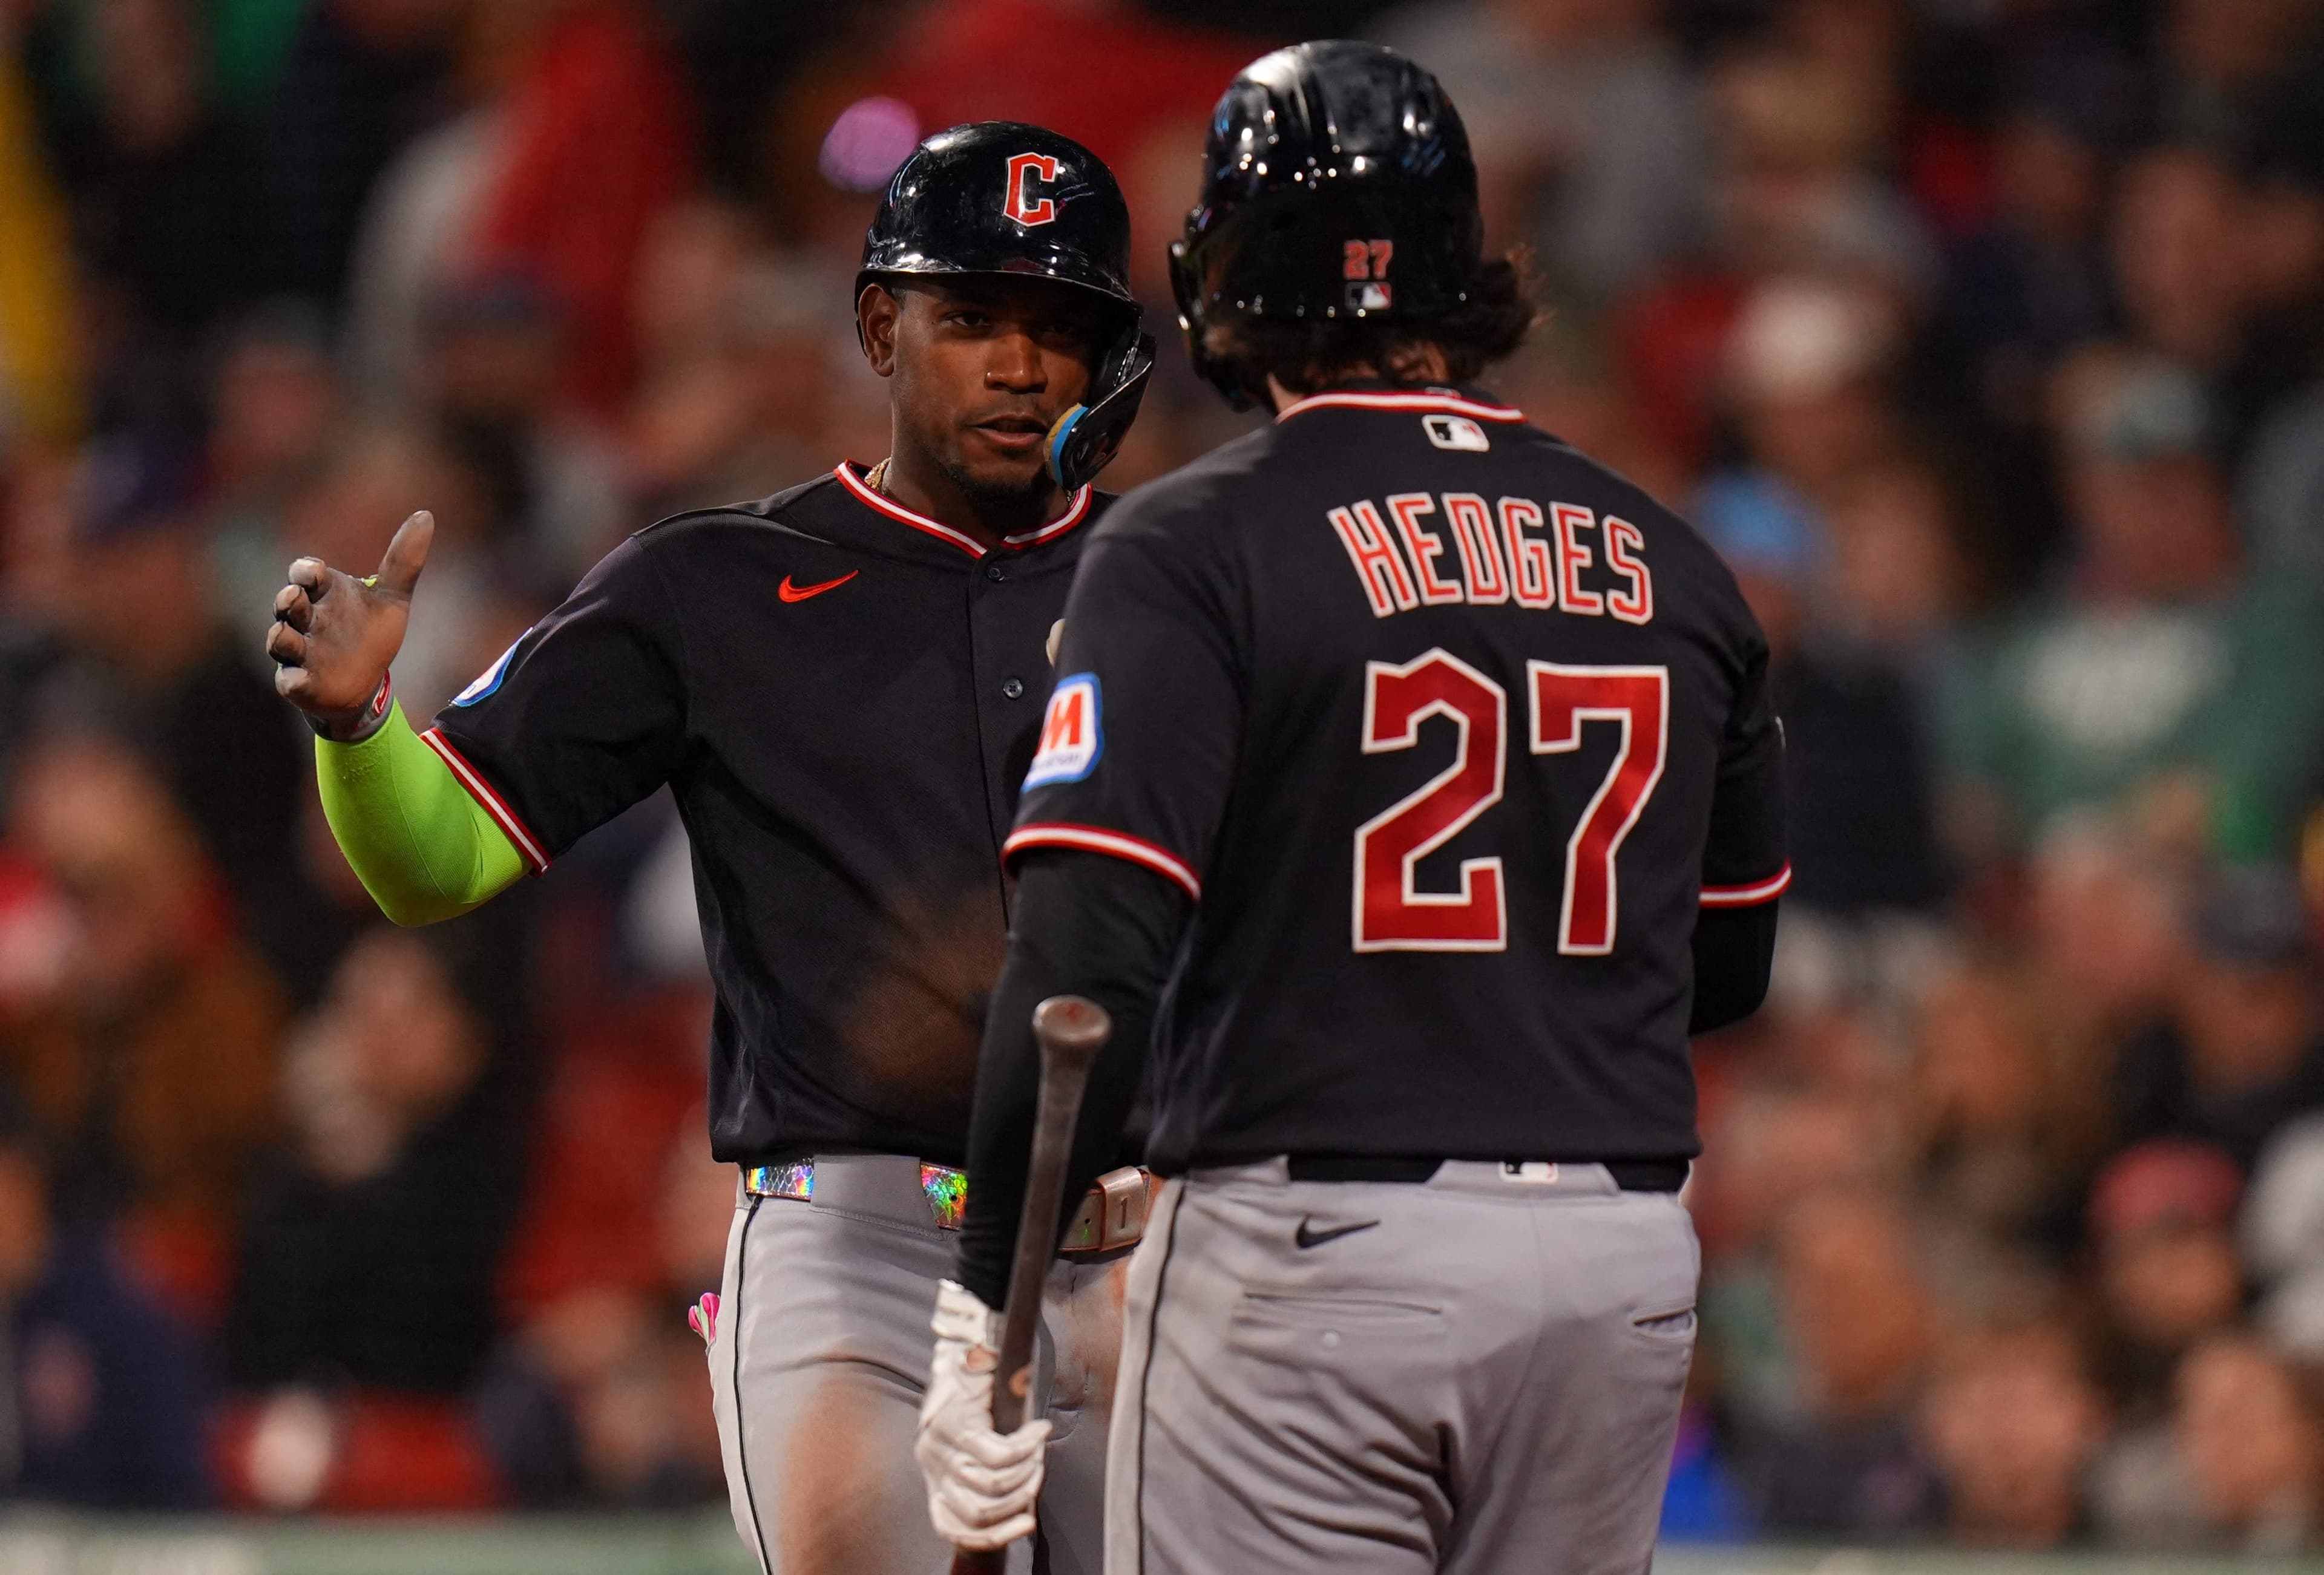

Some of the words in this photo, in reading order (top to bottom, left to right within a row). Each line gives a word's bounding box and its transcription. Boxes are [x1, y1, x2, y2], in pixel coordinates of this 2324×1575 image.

[1003, 152, 1059, 227] C
[1343, 239, 1393, 280] 27
[1327, 492, 1653, 625] HEDGES
[1048, 692, 1082, 750] M
[1353, 647, 1669, 955] 27
